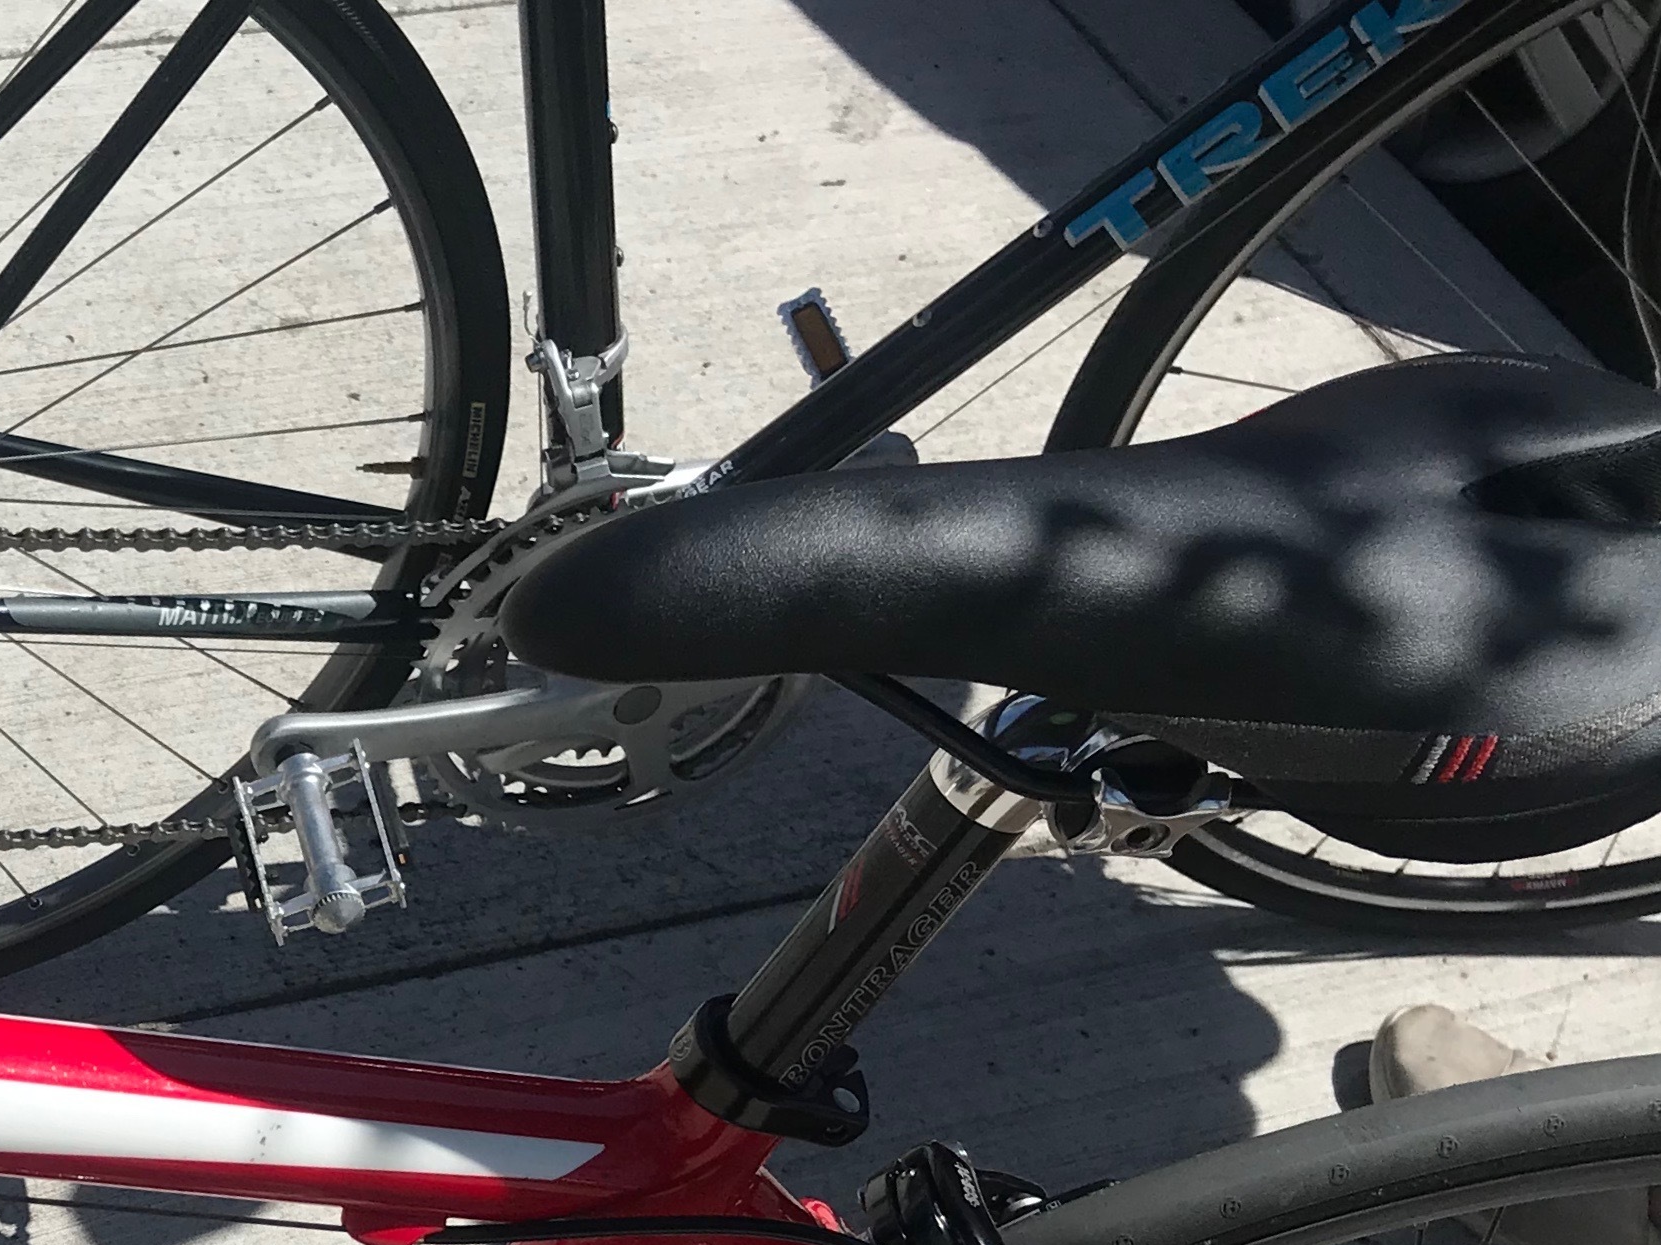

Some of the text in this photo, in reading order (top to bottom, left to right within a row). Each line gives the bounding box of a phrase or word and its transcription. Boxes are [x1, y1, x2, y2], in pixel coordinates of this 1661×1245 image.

[1064, 0, 1464, 252] TREK
[466, 405, 484, 474] MICHELIN
[779, 860, 987, 1089] BONTRAGER
